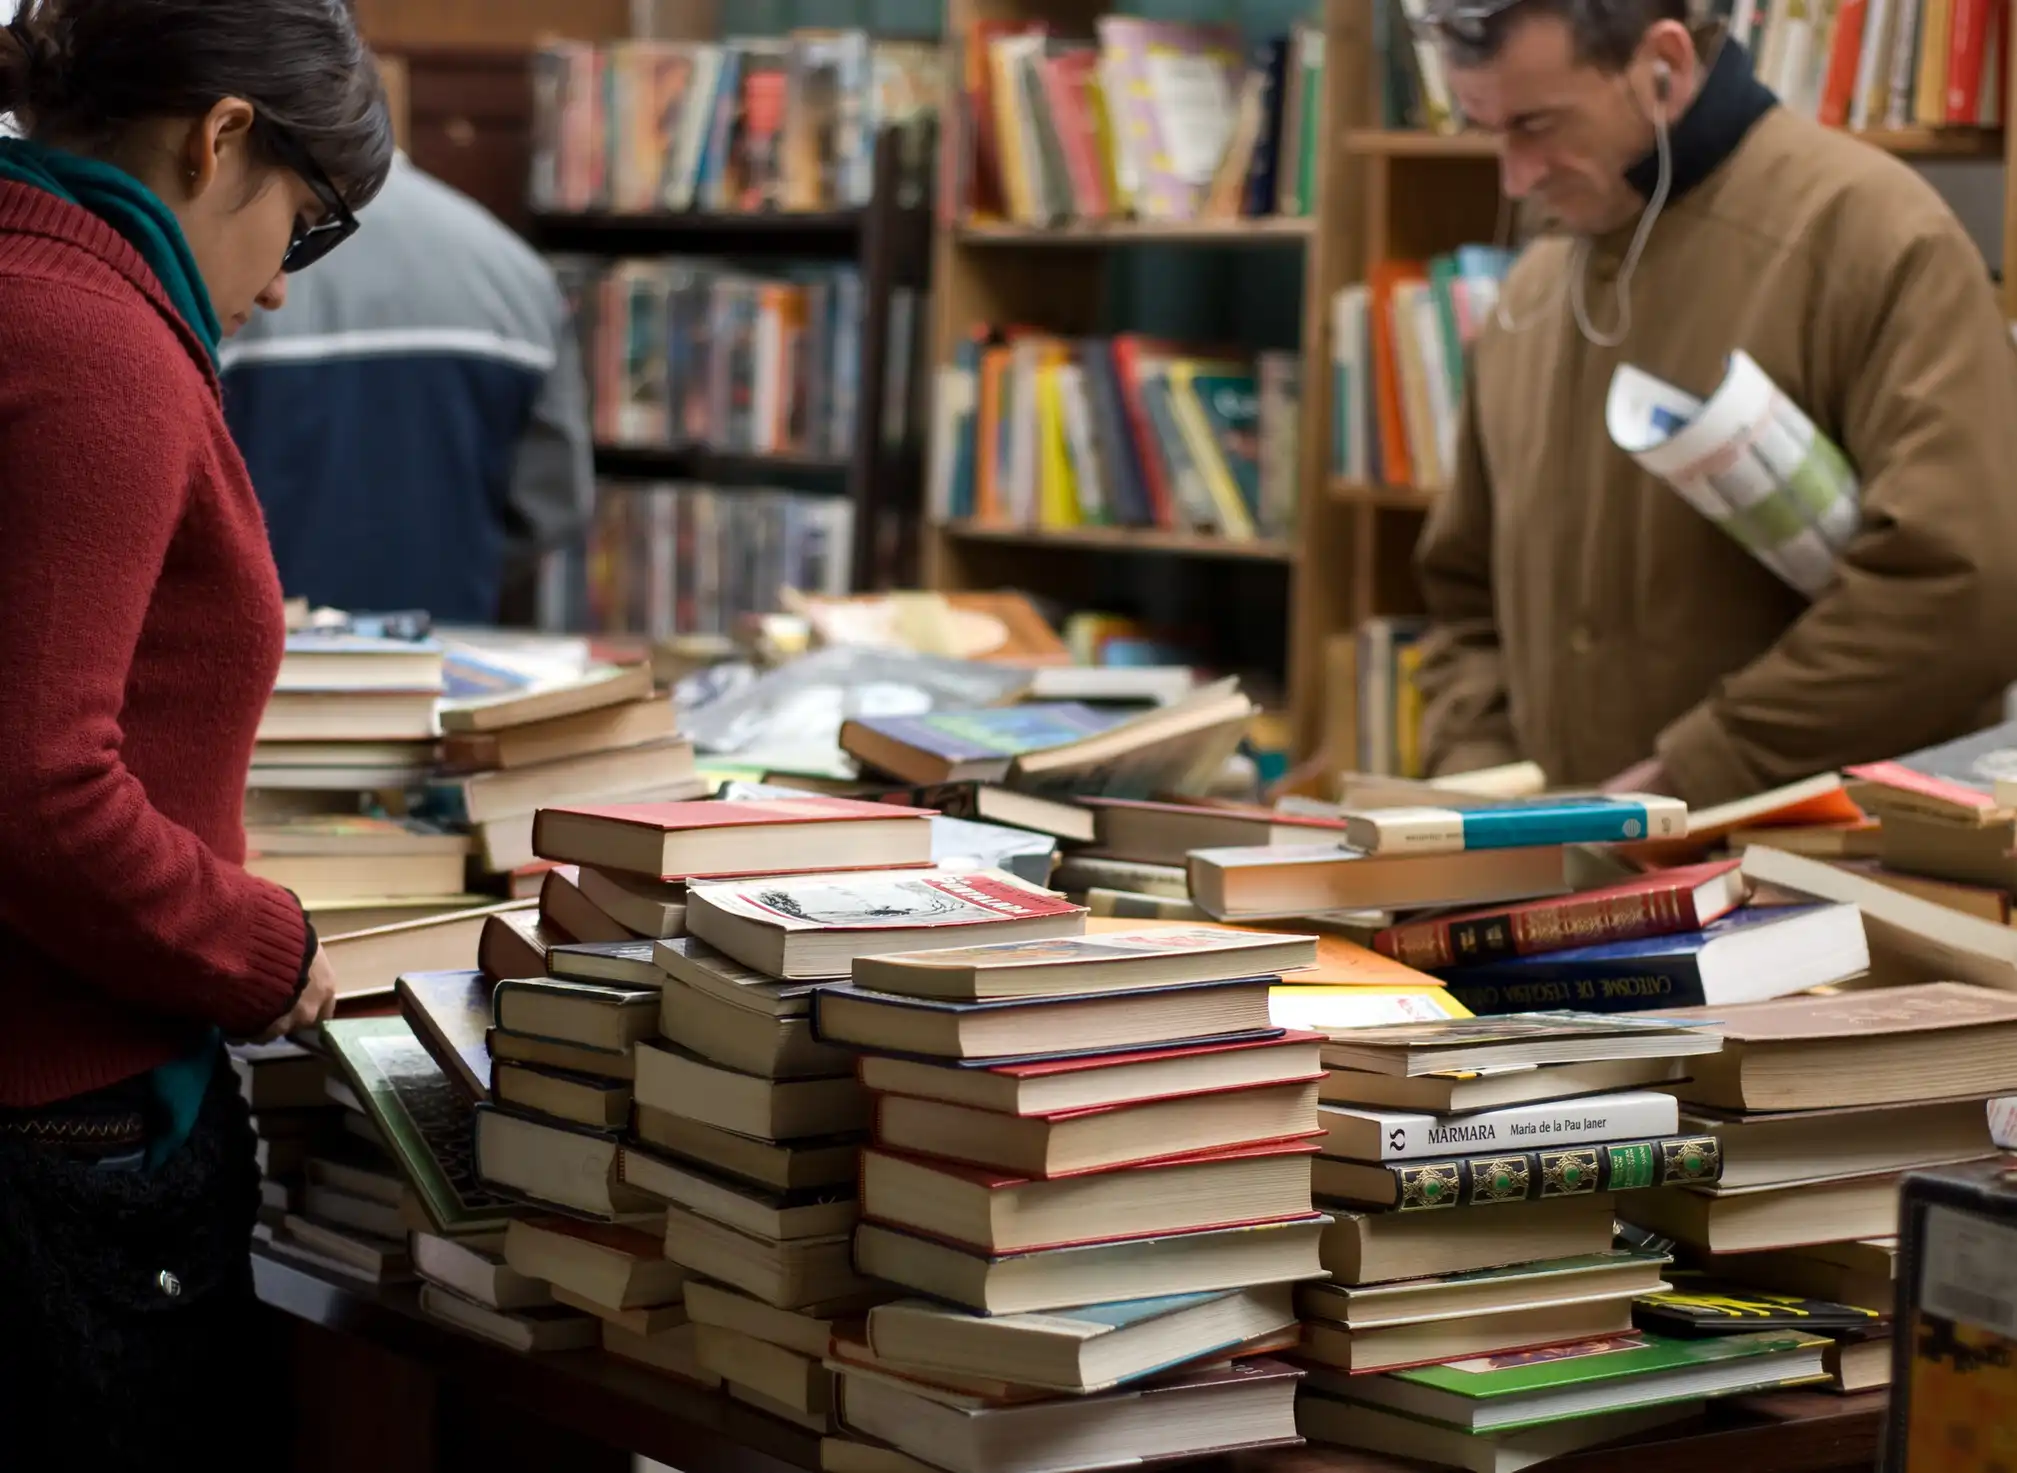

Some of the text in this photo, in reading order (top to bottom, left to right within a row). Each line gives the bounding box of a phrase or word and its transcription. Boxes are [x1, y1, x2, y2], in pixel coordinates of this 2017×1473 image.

[1575, 979, 1595, 999] DE
[1428, 1118, 1607, 1144] MÀRMARA Maria de la Pau Janer
